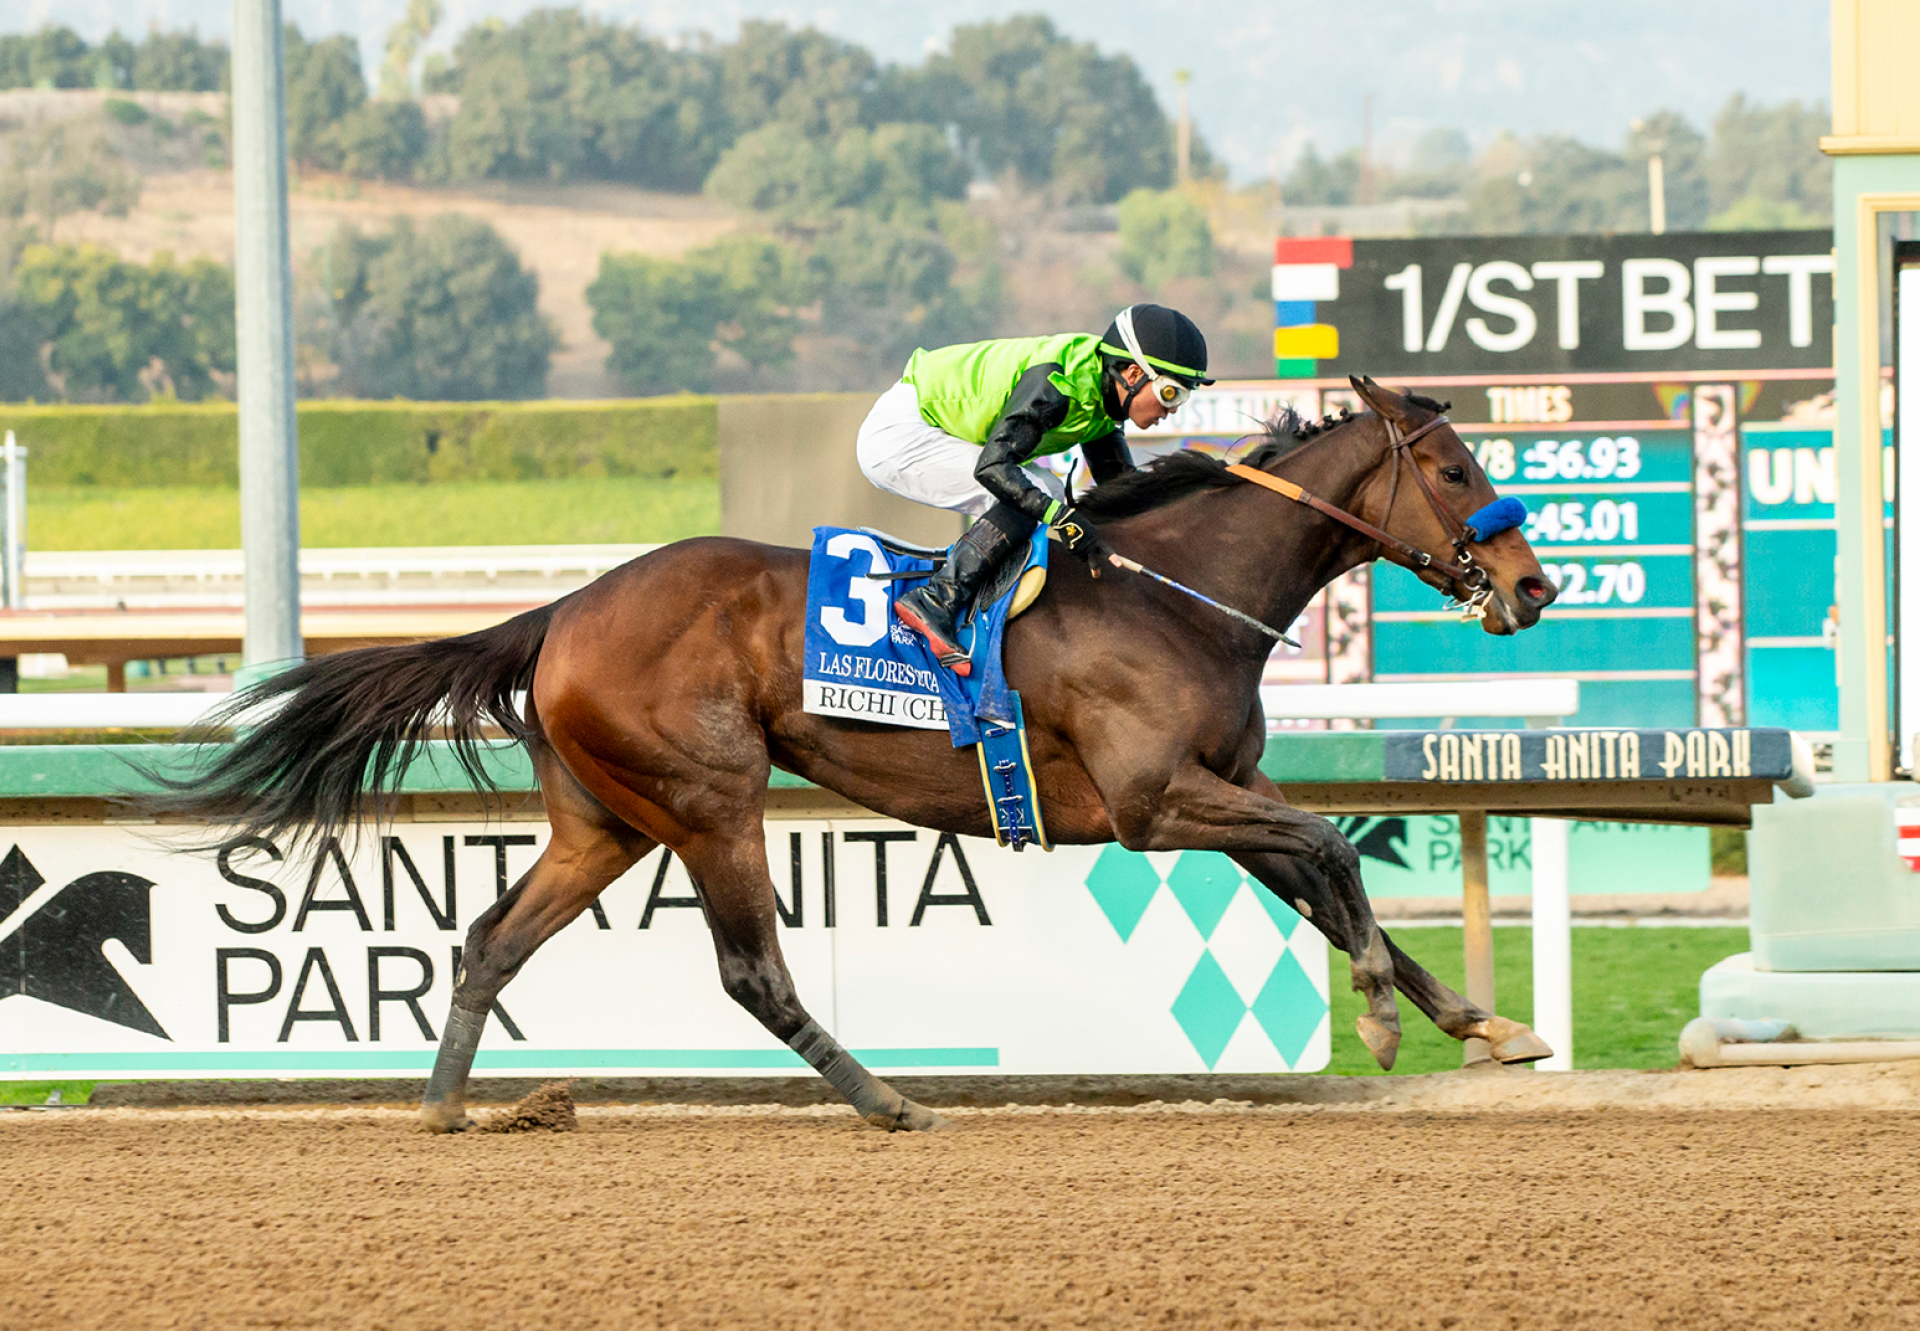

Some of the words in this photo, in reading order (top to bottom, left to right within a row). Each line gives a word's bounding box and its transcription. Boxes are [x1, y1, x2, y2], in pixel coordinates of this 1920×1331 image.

[1384, 260, 1604, 353] 1/ST
[1622, 254, 1836, 351] BET
[1486, 385, 1573, 423] TIMES
[1523, 436, 1642, 480] :56.93
[1748, 447, 1838, 504] UN
[1526, 499, 1639, 542] :45.01
[820, 533, 892, 648] 3
[818, 652, 852, 677] LAS
[854, 656, 916, 686] FLORES
[818, 686, 898, 716] RICHI
[902, 696, 949, 722] (CH
[1422, 733, 1522, 781] SANTA
[1540, 731, 1641, 779] ANITA
[1658, 729, 1751, 778] PARK
[215, 834, 612, 935] SANT
